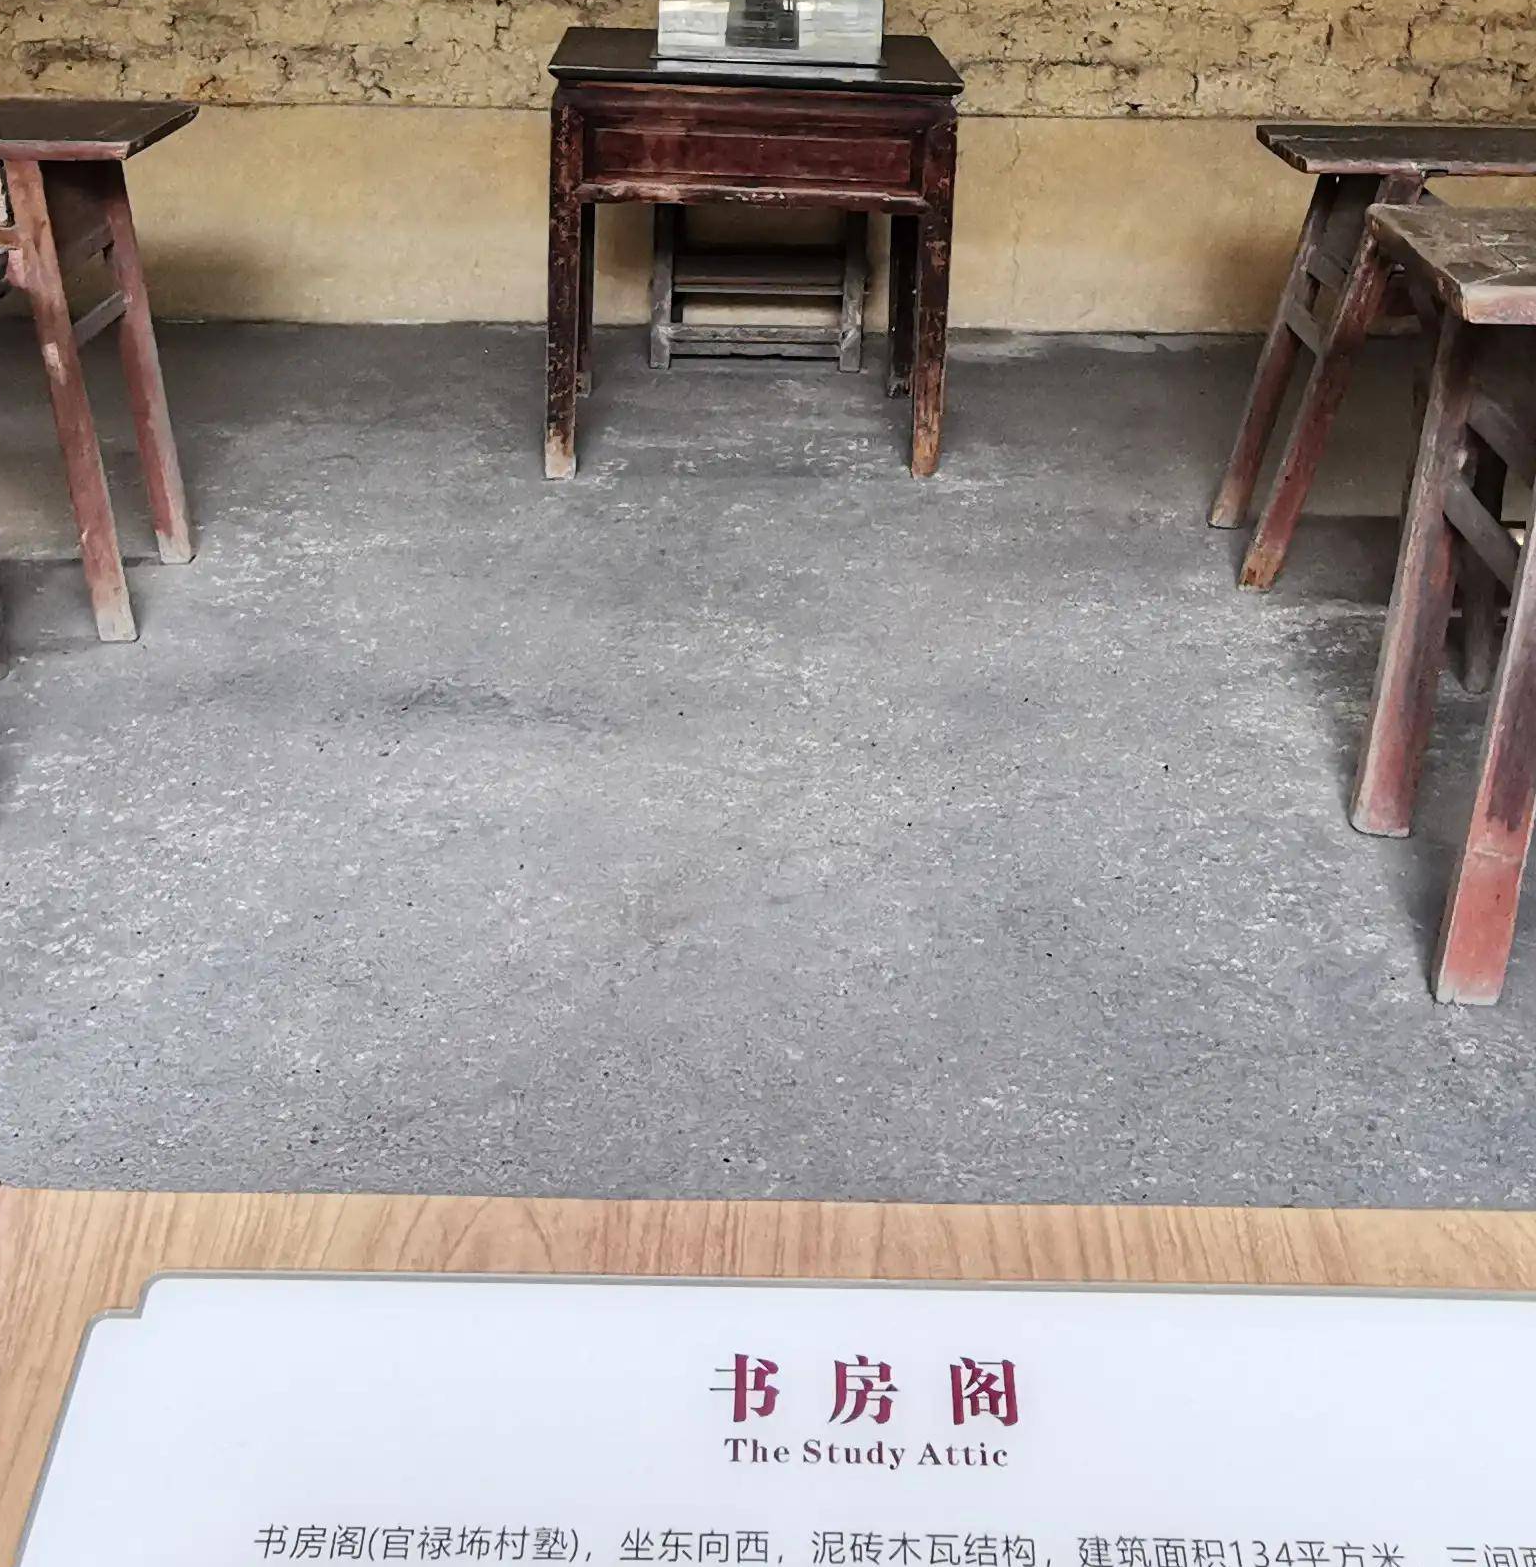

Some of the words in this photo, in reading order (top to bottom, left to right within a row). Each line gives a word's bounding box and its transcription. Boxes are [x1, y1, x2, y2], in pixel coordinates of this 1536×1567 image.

[708, 1352, 1019, 1427] 书房阁
[723, 1437, 790, 1464] The
[802, 1438, 906, 1471] Study
[916, 1441, 1008, 1468] Attic
